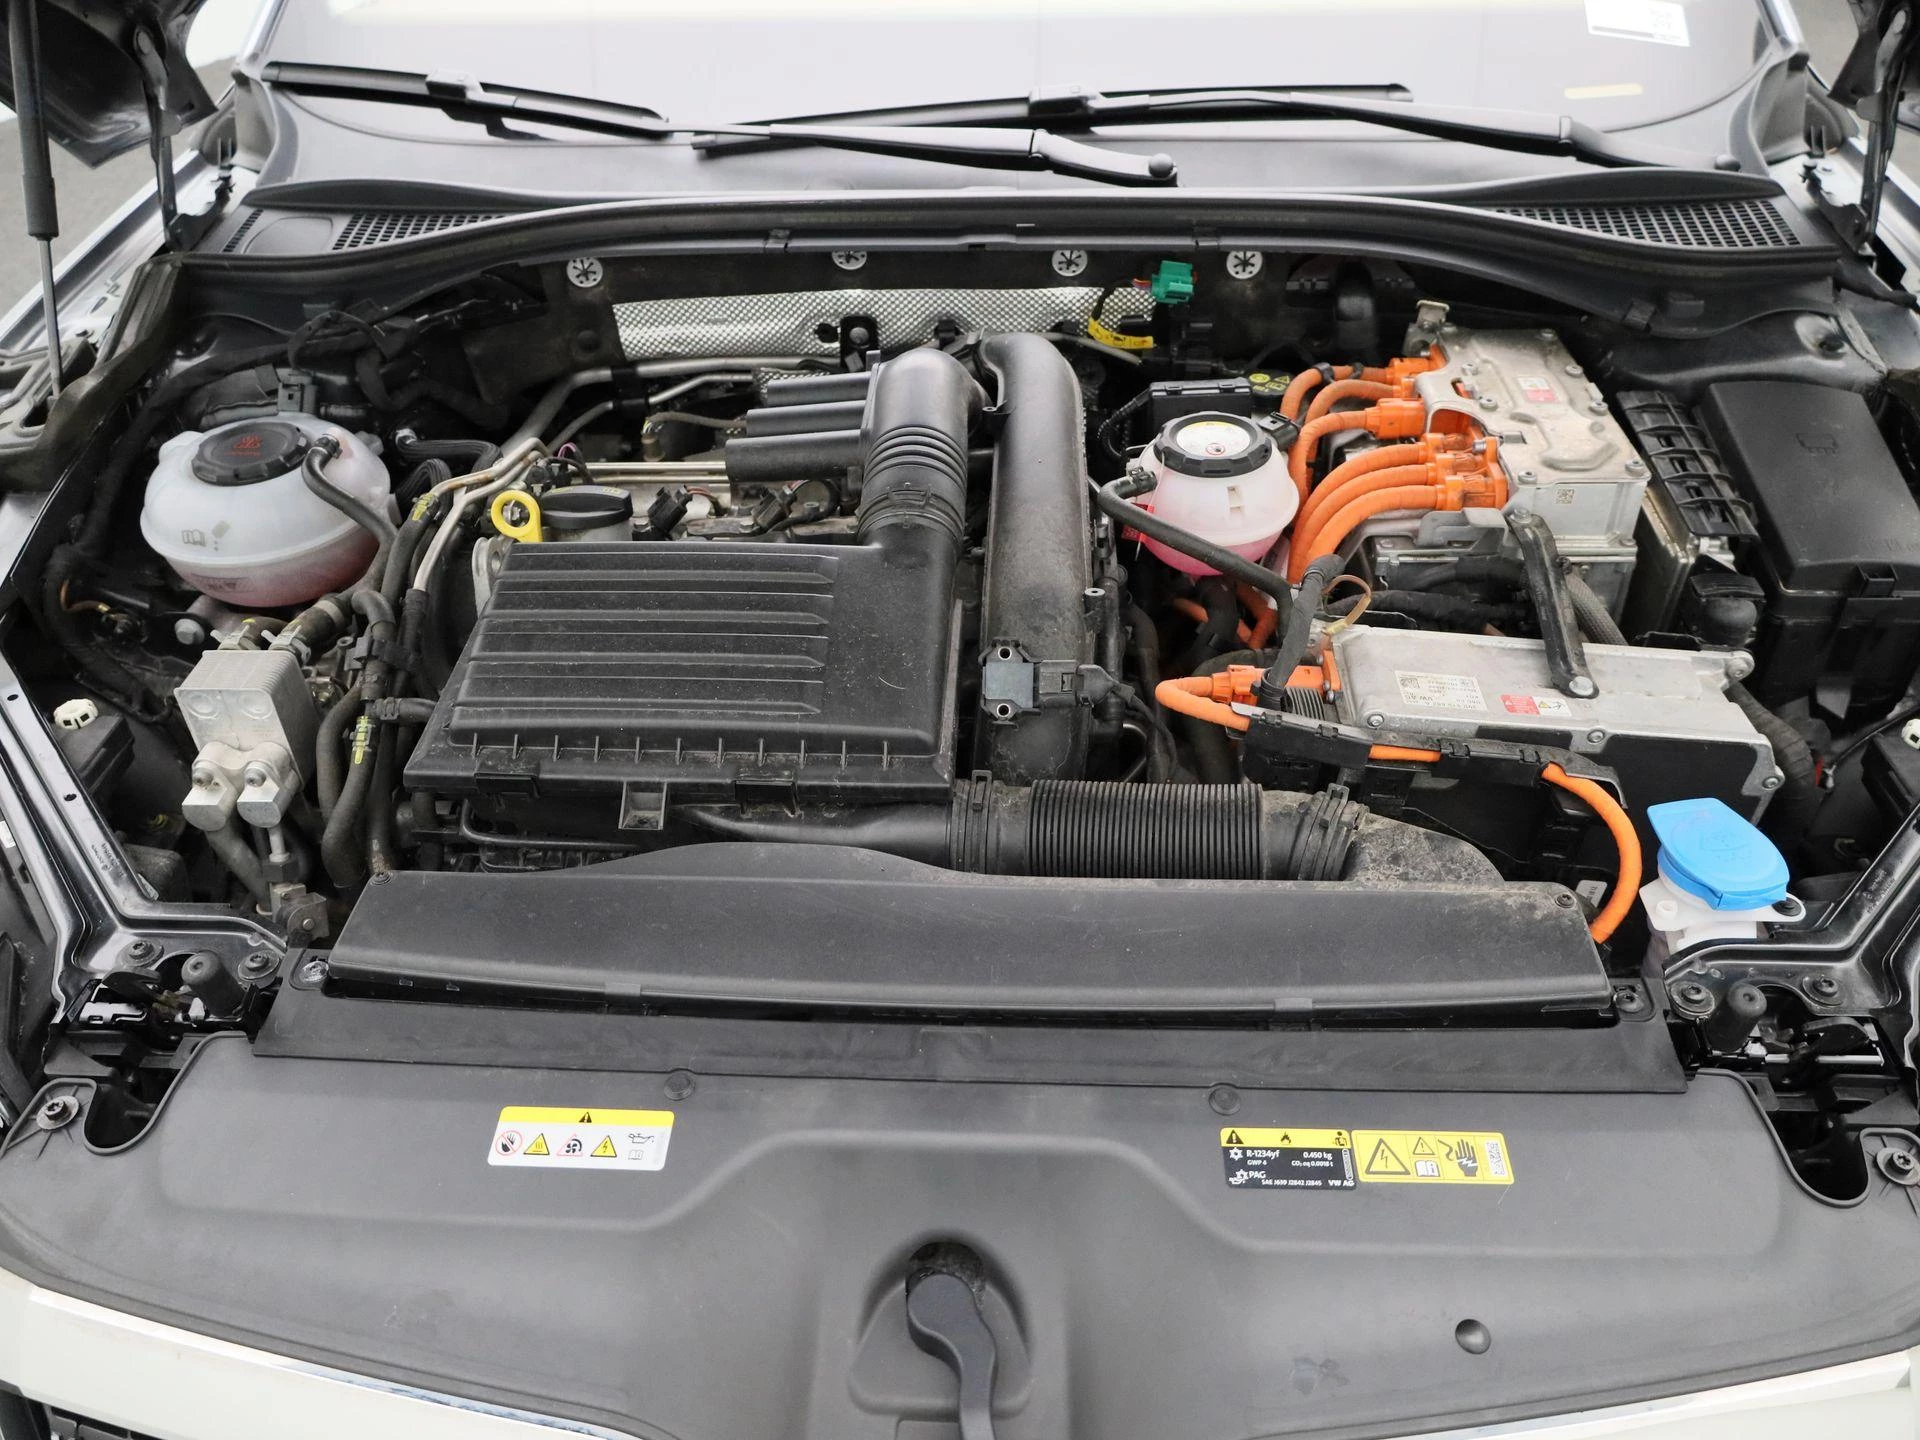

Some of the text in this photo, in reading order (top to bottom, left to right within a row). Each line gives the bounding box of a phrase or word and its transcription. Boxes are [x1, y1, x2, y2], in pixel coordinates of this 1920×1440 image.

[1246, 1149, 1279, 1160] R-1234yf
[1303, 1151, 1333, 1161] 0.450 kg
[1249, 1170, 1266, 1179] PAG
[1328, 1179, 1355, 1187] VW AG
